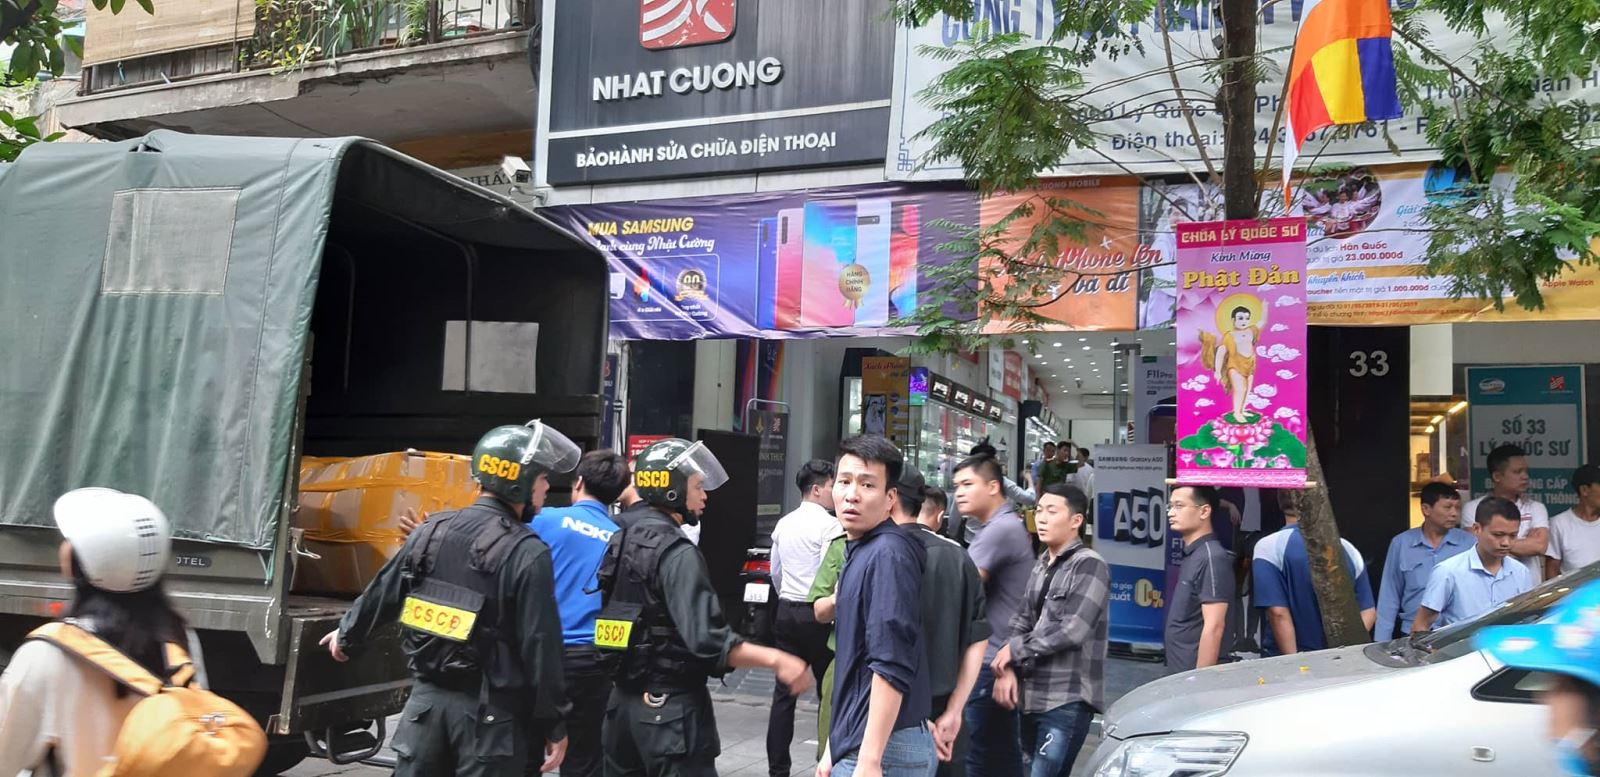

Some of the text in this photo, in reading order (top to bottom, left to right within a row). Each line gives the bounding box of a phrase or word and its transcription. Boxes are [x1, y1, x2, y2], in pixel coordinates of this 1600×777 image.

[593, 57, 783, 101] NHAT CUONG
[656, 139, 688, 161] SỬA
[690, 137, 738, 159] CHỮA
[740, 134, 780, 156] ĐIỆN
[784, 130, 837, 152] THOẠI
[1111, 132, 1157, 153] Điện
[587, 216, 695, 236] MUA SAMSUNG
[1181, 228, 1217, 243] CHÙA
[1220, 227, 1238, 241] LÝ
[1240, 225, 1278, 241] QUỐC
[646, 236, 678, 253] Nhật
[678, 234, 716, 253] Cường
[1361, 240, 1388, 250] Quốc
[1055, 246, 1126, 272] iPhone
[1345, 251, 1404, 261] 23.000.000đ
[1182, 264, 1301, 293] Phật Đản
[1569, 279, 1595, 287] Watch
[1349, 350, 1390, 378] 33
[1501, 413, 1547, 436] SỐ 33
[1548, 438, 1571, 456] SƯ
[478, 453, 521, 481] CSCĐ
[635, 470, 670, 488] CSCĐ
[1114, 493, 1164, 540] A50
[413, 605, 461, 630] CSCĐ
[596, 623, 626, 642] CSCĐ
